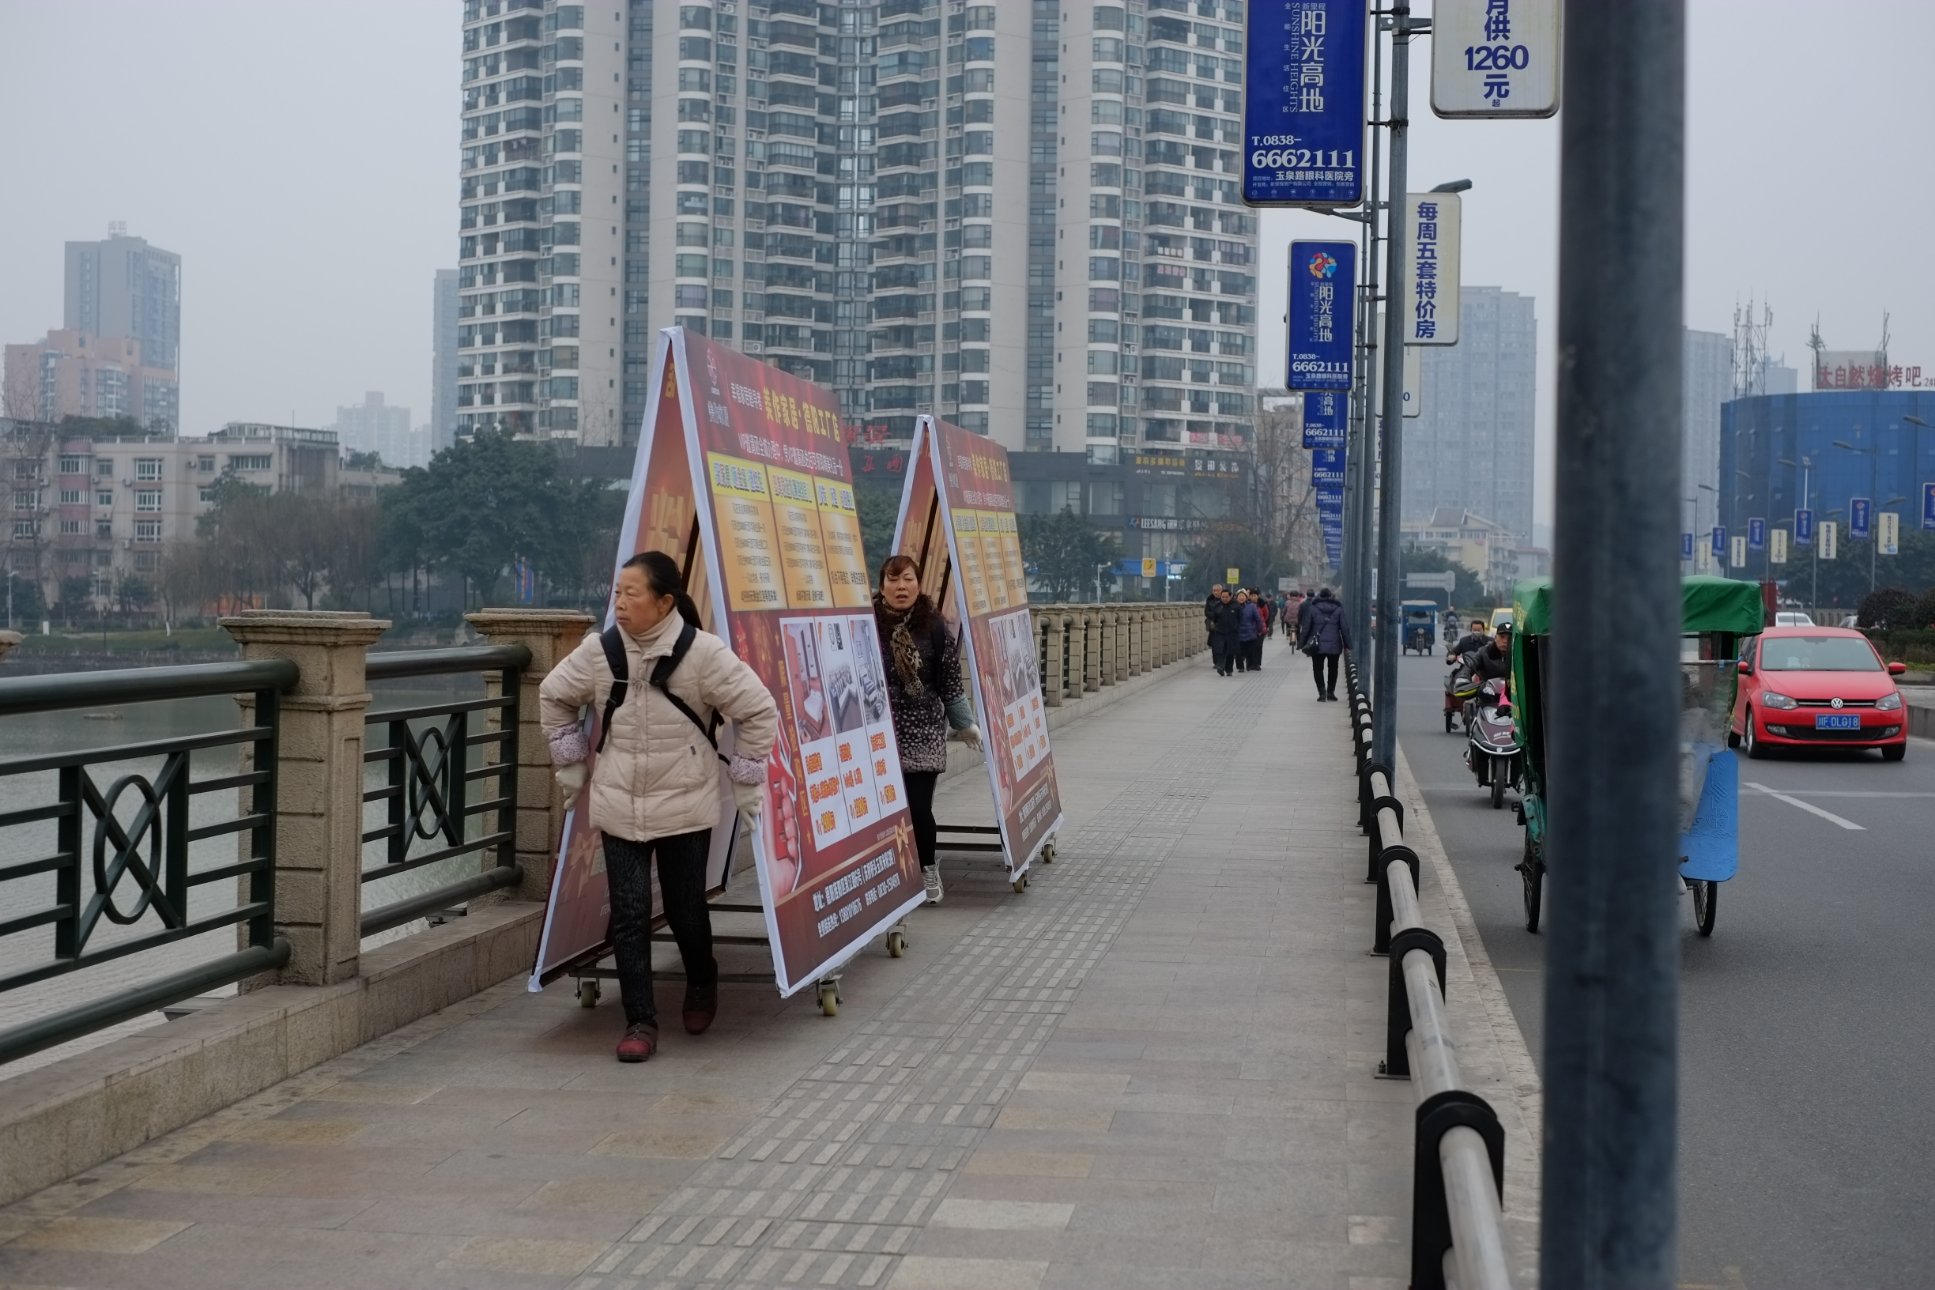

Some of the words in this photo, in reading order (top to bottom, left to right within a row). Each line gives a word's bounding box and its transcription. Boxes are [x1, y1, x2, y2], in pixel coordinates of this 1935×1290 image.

[1291, 2, 1300, 60] SUNSHINE
[1299, 11, 1326, 112] 阳光高地
[1465, 45, 1529, 70] 1260
[1290, 63, 1298, 112] HEIGHTS
[1484, 74, 1510, 99] 元
[1492, 99, 1501, 107] 起
[1252, 149, 1355, 168] 6662111
[1275, 170, 1354, 181] 玉泉路眼科医院旁
[1415, 202, 1437, 339] 每周五套特价房
[1318, 286, 1334, 342] 阳光高地
[1292, 361, 1349, 373] 6662111
[1305, 428, 1344, 437] 6662111
